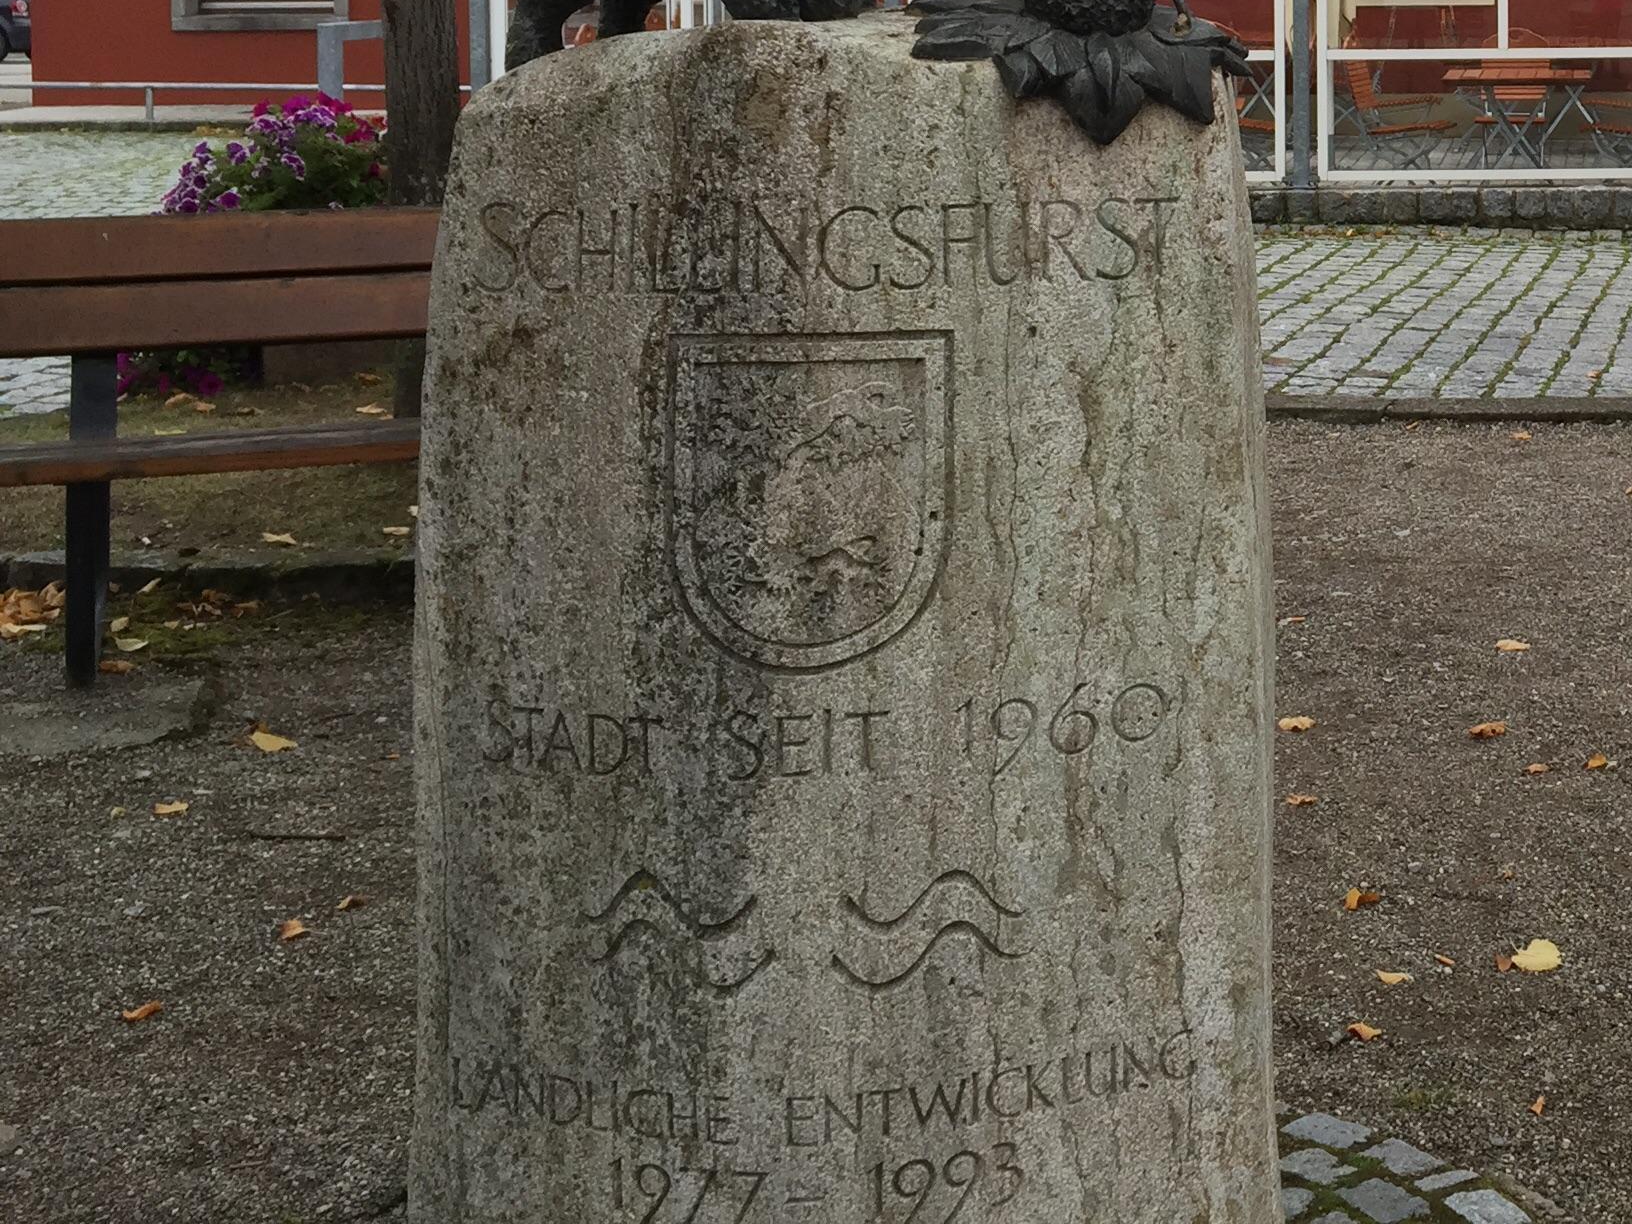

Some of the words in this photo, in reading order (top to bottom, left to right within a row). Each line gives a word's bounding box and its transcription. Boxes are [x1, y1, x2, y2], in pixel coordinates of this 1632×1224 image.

[482, 699, 664, 776] STADT
[720, 707, 890, 778] SEIT
[954, 682, 1168, 793] 1960
[785, 1030, 1196, 1147] ENTWICKLUNG
[607, 1156, 769, 1224] 1977
[867, 1142, 1023, 1224] 1993
